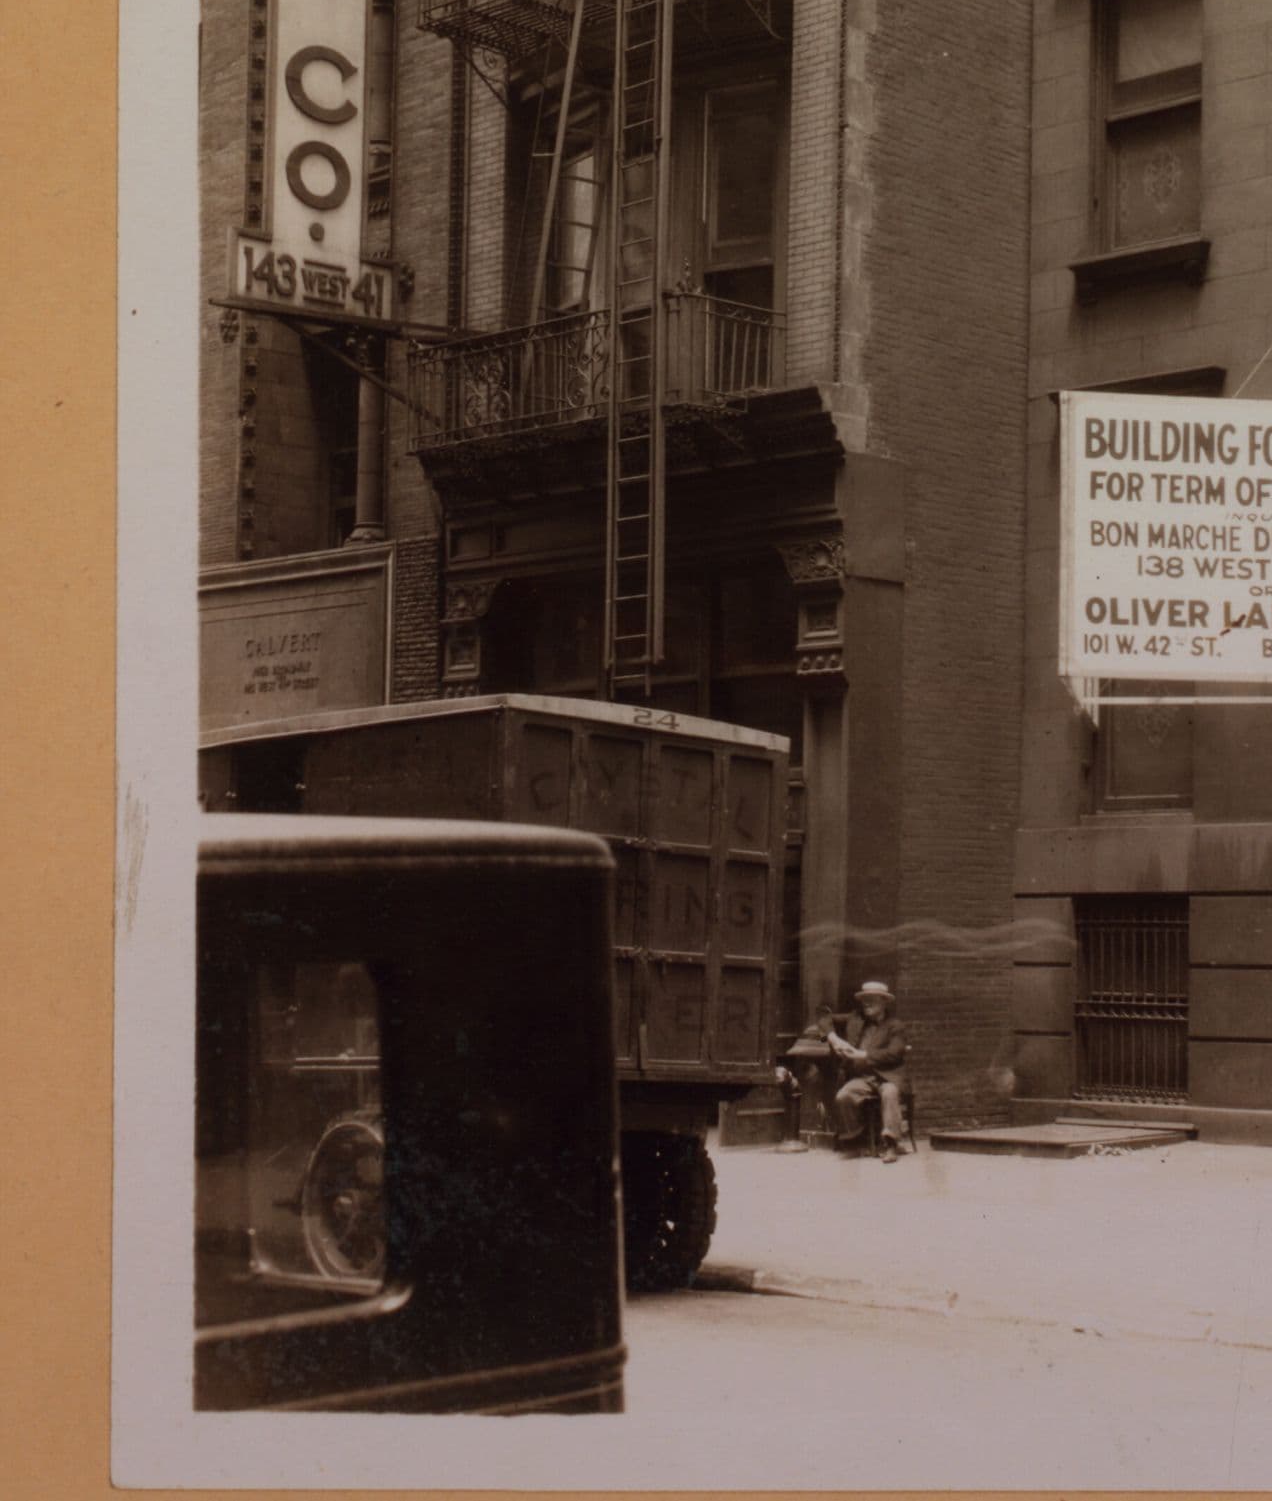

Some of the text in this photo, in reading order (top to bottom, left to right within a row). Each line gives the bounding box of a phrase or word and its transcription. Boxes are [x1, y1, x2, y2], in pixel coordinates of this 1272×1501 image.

[285, 44, 358, 242] CO.
[244, 246, 384, 318] 143 WEST 41
[1085, 418, 1239, 465] BUILDING
[1090, 472, 1143, 502] FOR
[1152, 474, 1226, 505] TERM
[1236, 478, 1272, 507] OF
[1091, 520, 1138, 548] BON
[1149, 523, 1240, 552] MARCHE
[1138, 555, 1184, 578] 138
[1194, 557, 1270, 581] WEST
[1085, 597, 1210, 628] OLIVER
[1084, 633, 1108, 654] 101
[1115, 635, 1138, 655] W.
[1190, 637, 1222, 658] ST.
[633, 707, 680, 731] 24
